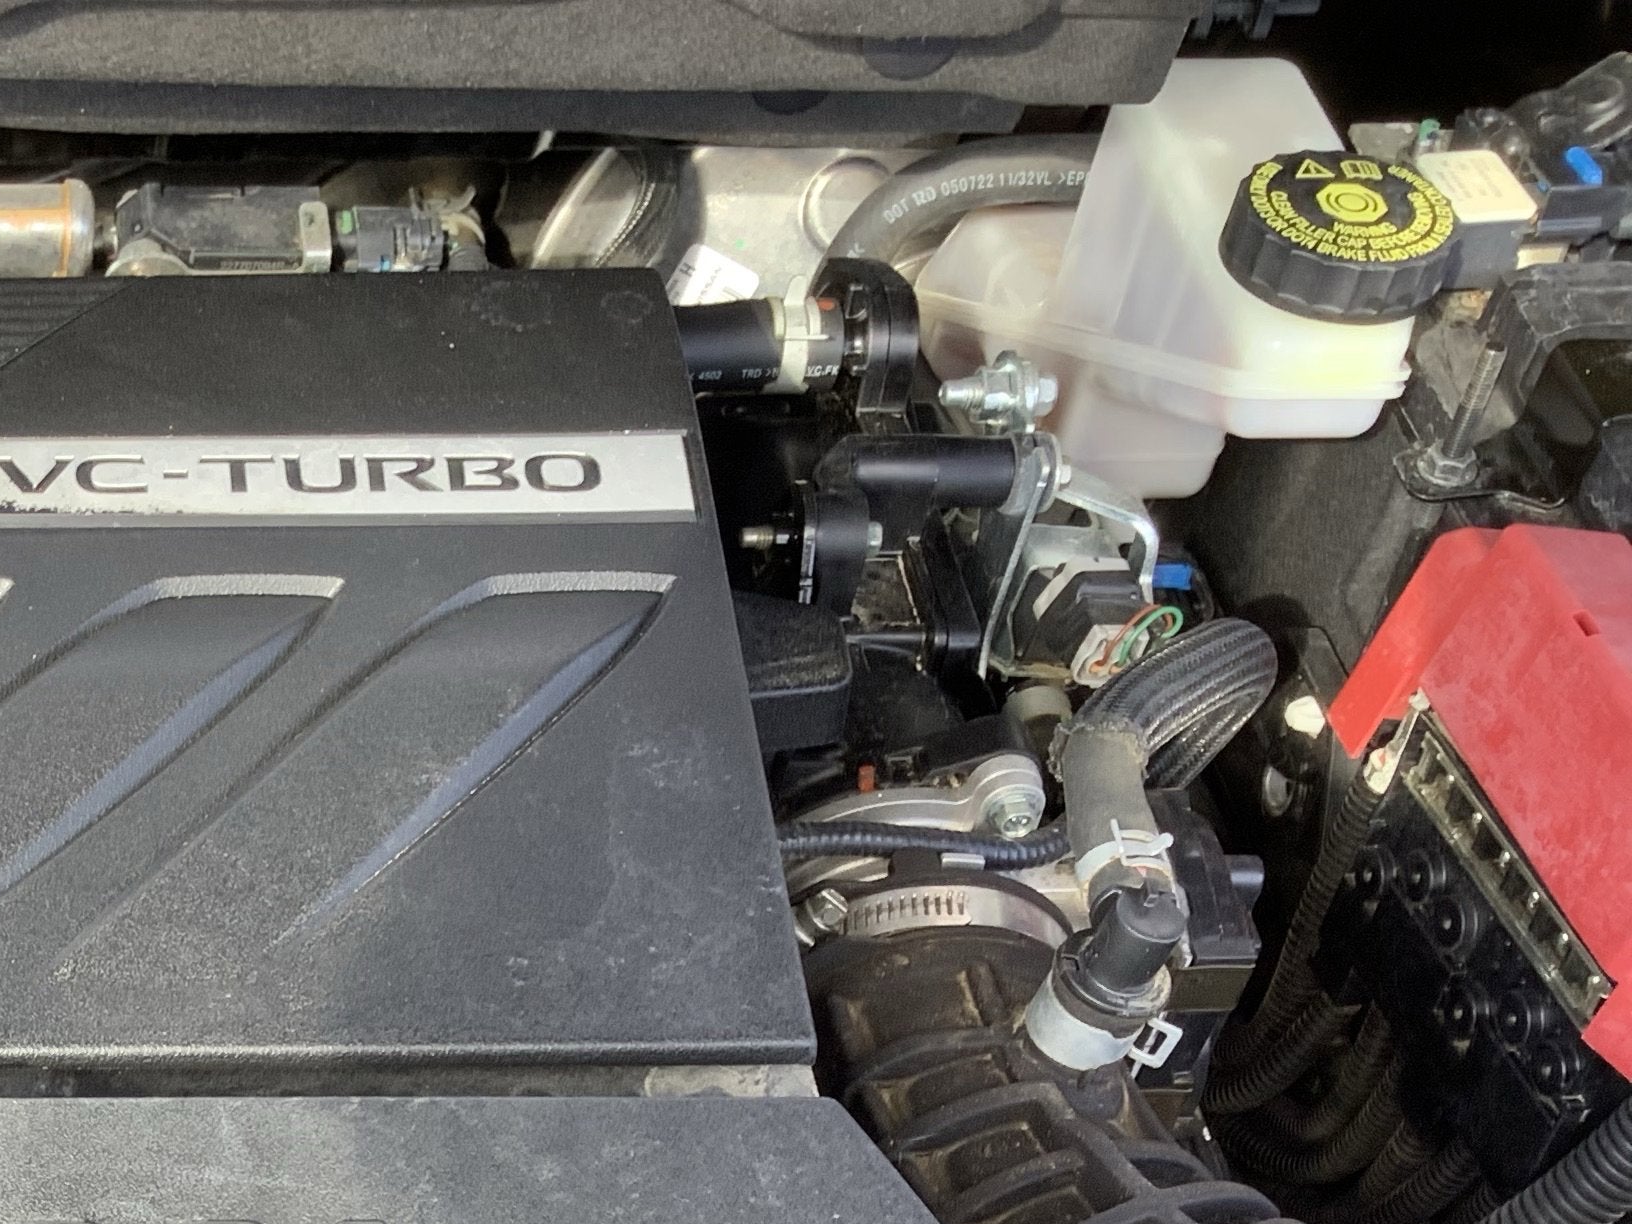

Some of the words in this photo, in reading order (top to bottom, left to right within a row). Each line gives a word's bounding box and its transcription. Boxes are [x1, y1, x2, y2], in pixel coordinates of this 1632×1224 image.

[940, 173, 994, 197] 050722
[1270, 191, 1298, 222] CLEAN
[1289, 215, 1337, 244] FILLER
[1337, 234, 1368, 249] CAP
[1369, 226, 1425, 251] BEFORE
[1332, 221, 1398, 236] WARNING
[1282, 226, 1317, 247] DOT4
[1316, 241, 1368, 261] BRAKE
[1369, 245, 1410, 262] FLUID
